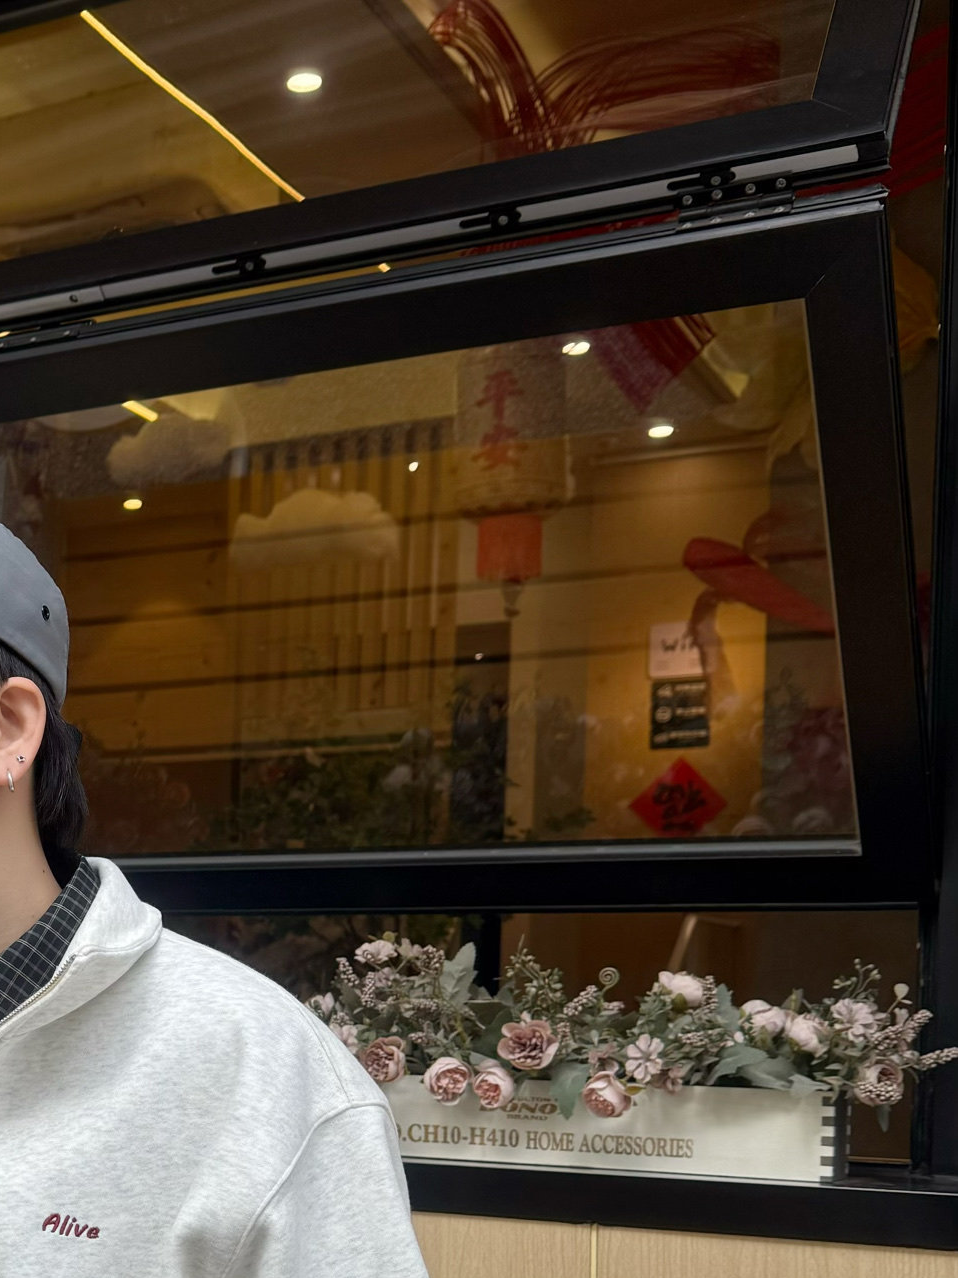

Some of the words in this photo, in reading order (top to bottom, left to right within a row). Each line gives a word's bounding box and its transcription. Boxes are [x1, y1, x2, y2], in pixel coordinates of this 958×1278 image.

[397, 1123, 519, 1148] .CH10-H410
[526, 1130, 575, 1153] HOME
[579, 1133, 694, 1159] ACCESSORIES
[41, 1213, 100, 1239] Alive
